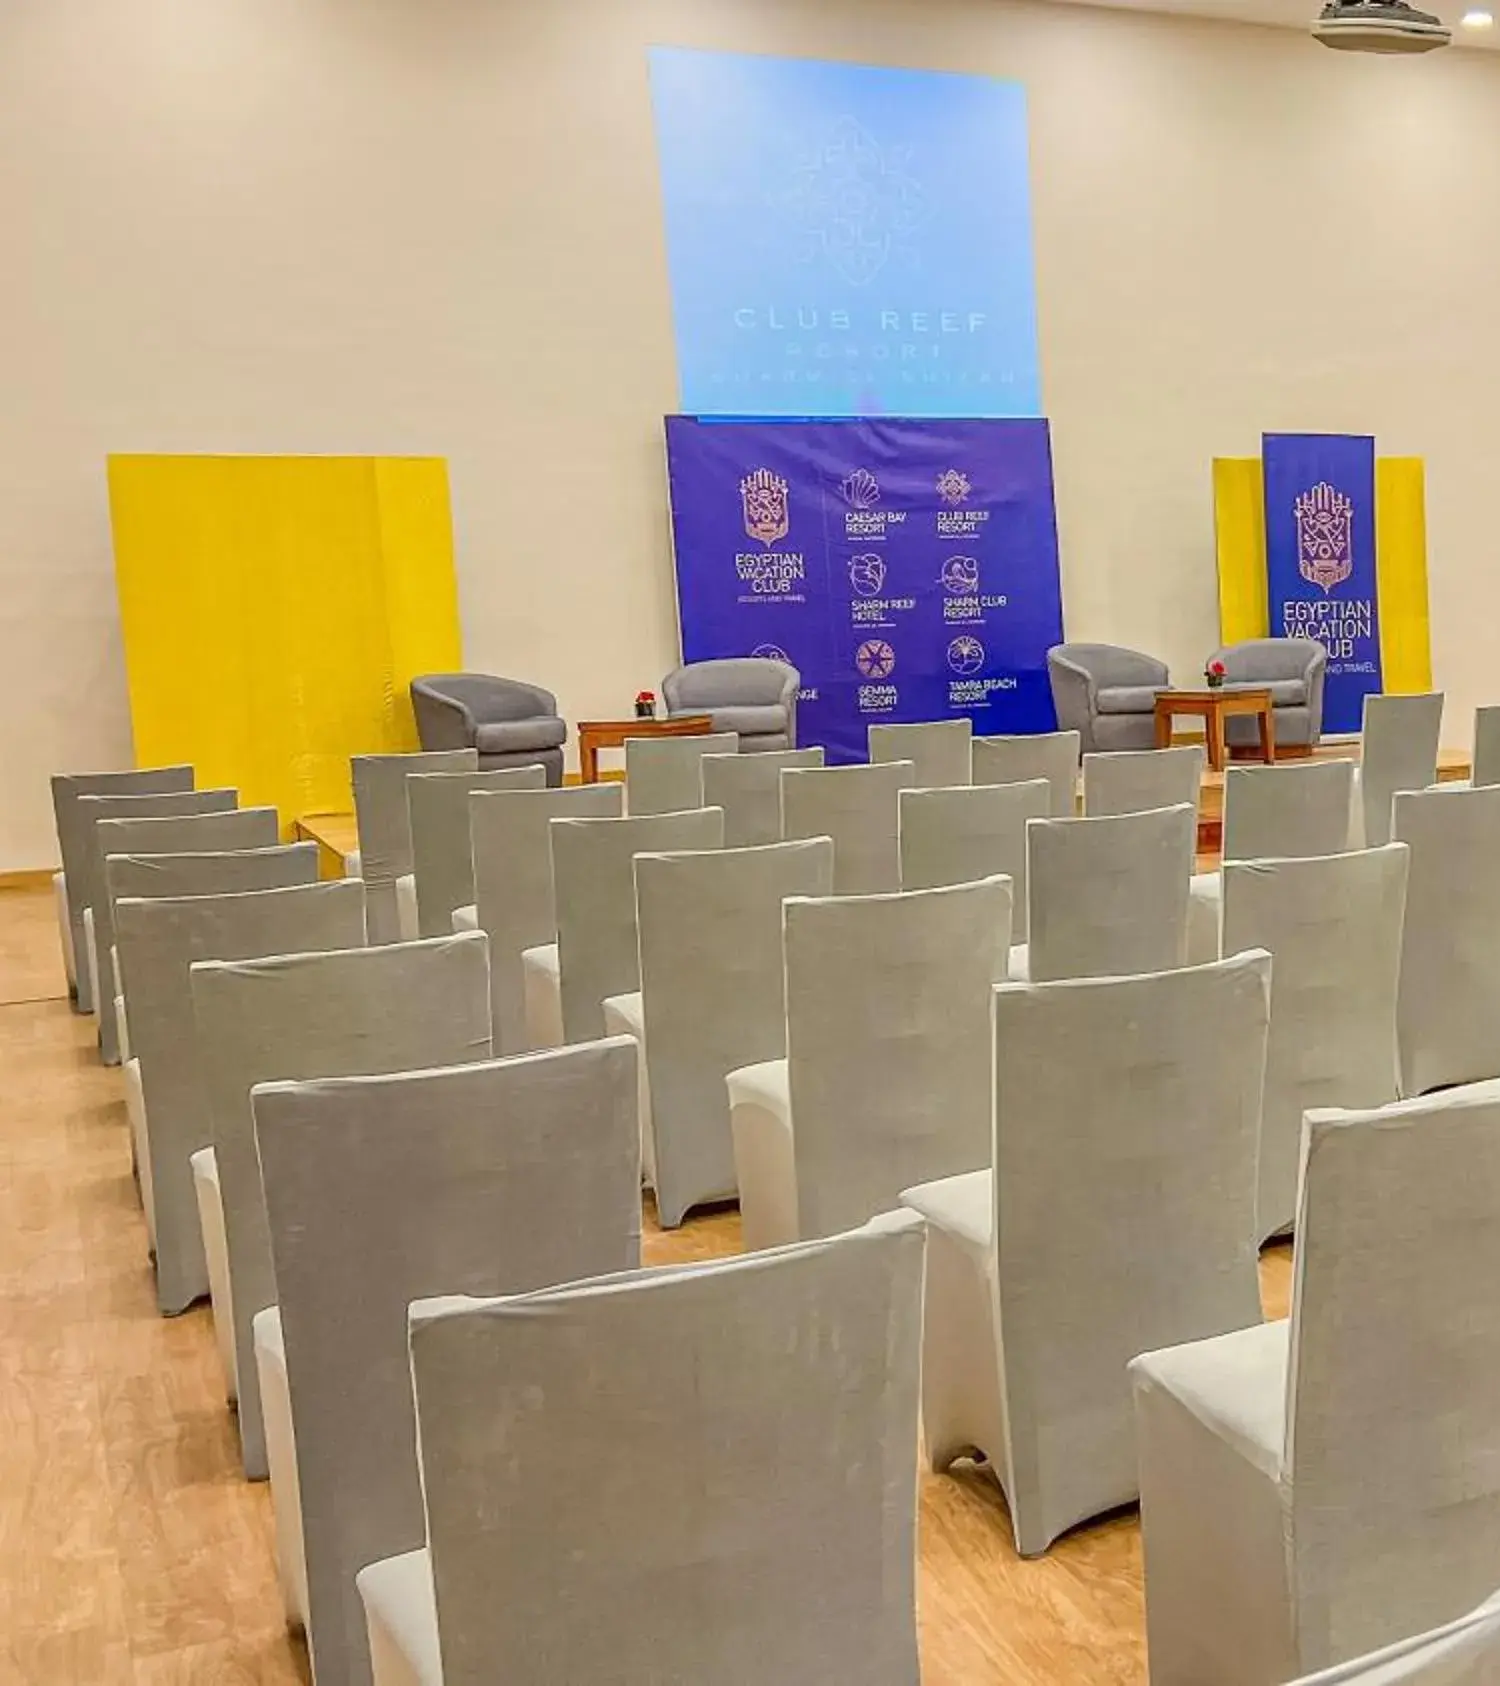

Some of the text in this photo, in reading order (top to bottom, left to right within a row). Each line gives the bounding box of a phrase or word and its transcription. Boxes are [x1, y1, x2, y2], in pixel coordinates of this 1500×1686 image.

[733, 306, 987, 333] CLUB REEF
[845, 512, 907, 523] CAESAR BAY
[845, 523, 885, 534] RESORT
[937, 521, 976, 532] RESORT
[735, 553, 804, 568] EGYPTIAN
[736, 566, 805, 580] VACATION
[752, 579, 791, 593] CLUB
[851, 599, 889, 611] SHARM
[943, 595, 1008, 608] SHARM CLUB
[852, 610, 887, 621] HOTEL
[943, 607, 982, 618] RESORT
[1283, 600, 1371, 620] EGYPTIAN
[1283, 619, 1371, 640] VACATION
[1327, 639, 1354, 659] UB
[984, 678, 1017, 690] BEACH
[860, 695, 898, 706] RESORT
[949, 690, 987, 702] RESORT
